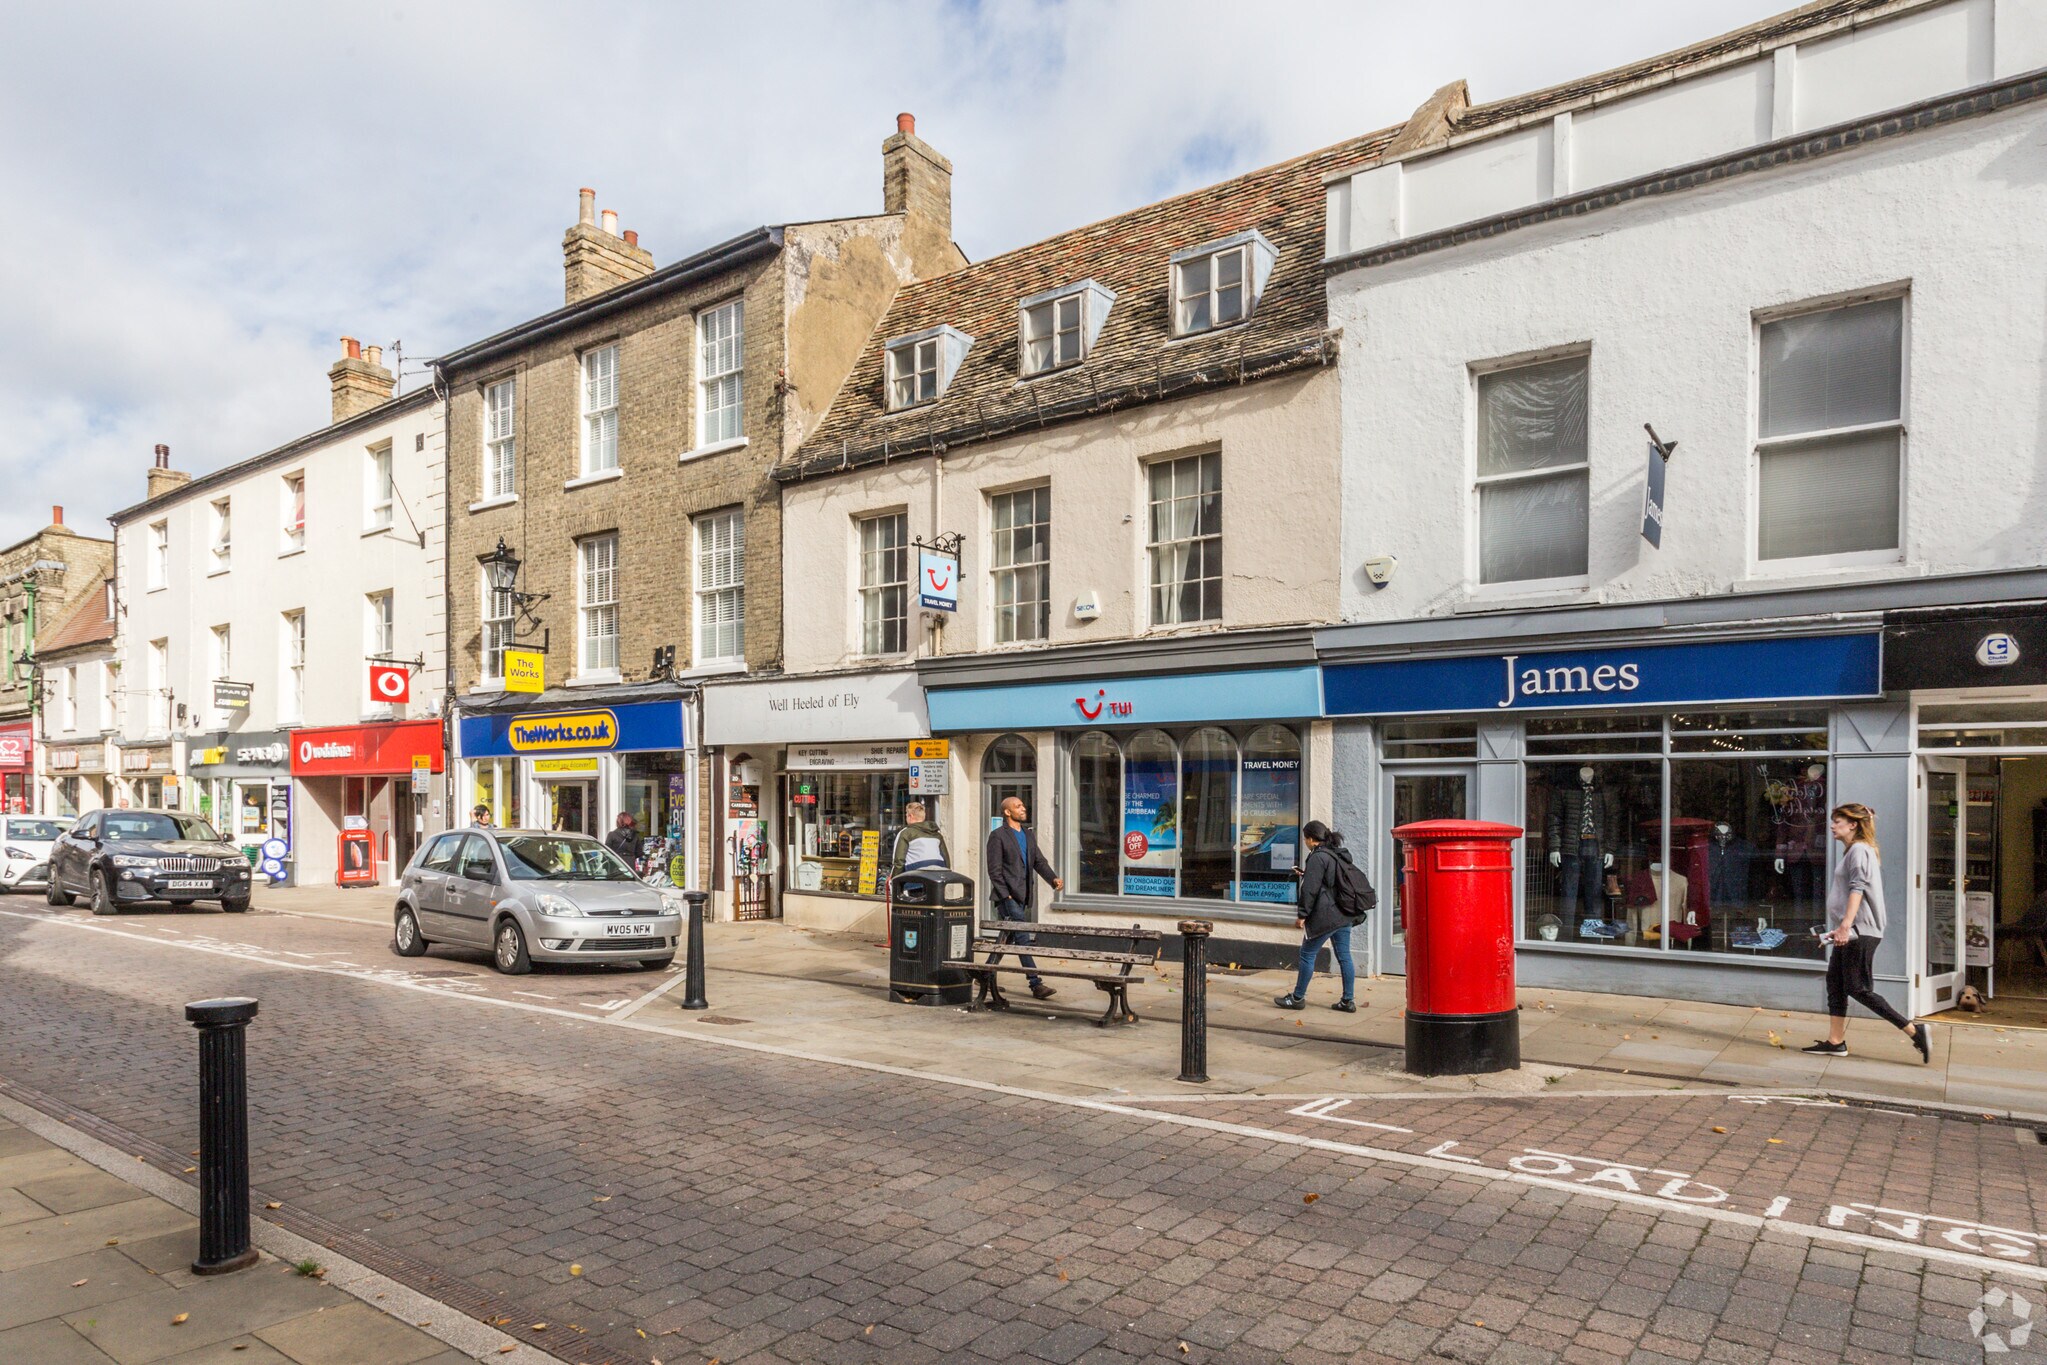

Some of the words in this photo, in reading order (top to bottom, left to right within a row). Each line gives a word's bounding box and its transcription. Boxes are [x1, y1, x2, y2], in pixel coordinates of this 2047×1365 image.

[517, 659, 534, 669] The
[510, 668, 540, 679] Works
[1498, 656, 1640, 707] James
[769, 698, 788, 711] Well
[793, 696, 824, 710] Heeled
[828, 694, 839, 708] of
[844, 693, 860, 709] Ely
[1109, 702, 1132, 715] TUI
[514, 720, 610, 744] TheWorks.co.uk
[312, 742, 351, 759] vodafone
[886, 746, 907, 754] REPAIRS
[1244, 761, 1271, 769] TRAVEL
[800, 785, 810, 794] KEY
[670, 789, 685, 807] Eve
[794, 795, 816, 803] CUTTING
[1250, 809, 1277, 817] CRUISES
[1129, 842, 1142, 851] OFF
[1134, 877, 1162, 885] ONBOARD
[1240, 882, 1267, 890] ORWAY'S
[607, 925, 631, 934] MV05
[633, 924, 651, 934] NFM
[1425, 1141, 2034, 1258] LOADING
